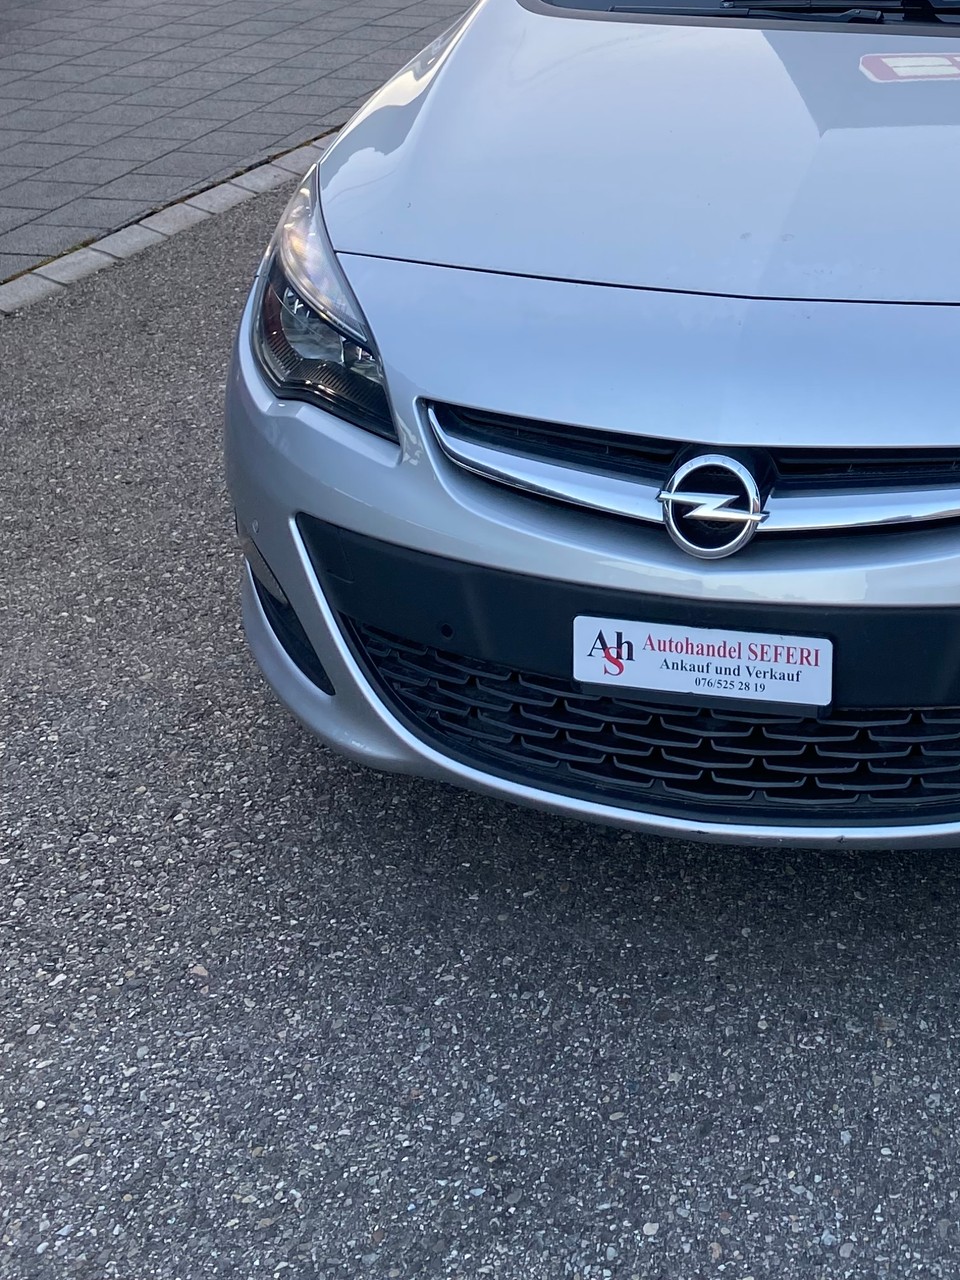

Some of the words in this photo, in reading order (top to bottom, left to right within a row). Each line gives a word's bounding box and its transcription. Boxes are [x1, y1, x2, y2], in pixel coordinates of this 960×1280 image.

[642, 633, 742, 660] Autohandel
[748, 642, 821, 667] SEFERI
[660, 658, 712, 675] Ankauf
[715, 665, 741, 677] und
[746, 665, 802, 683] Verkauf
[694, 677, 735, 690] 076/525
[738, 681, 751, 691] 28
[754, 683, 766, 693] 19
